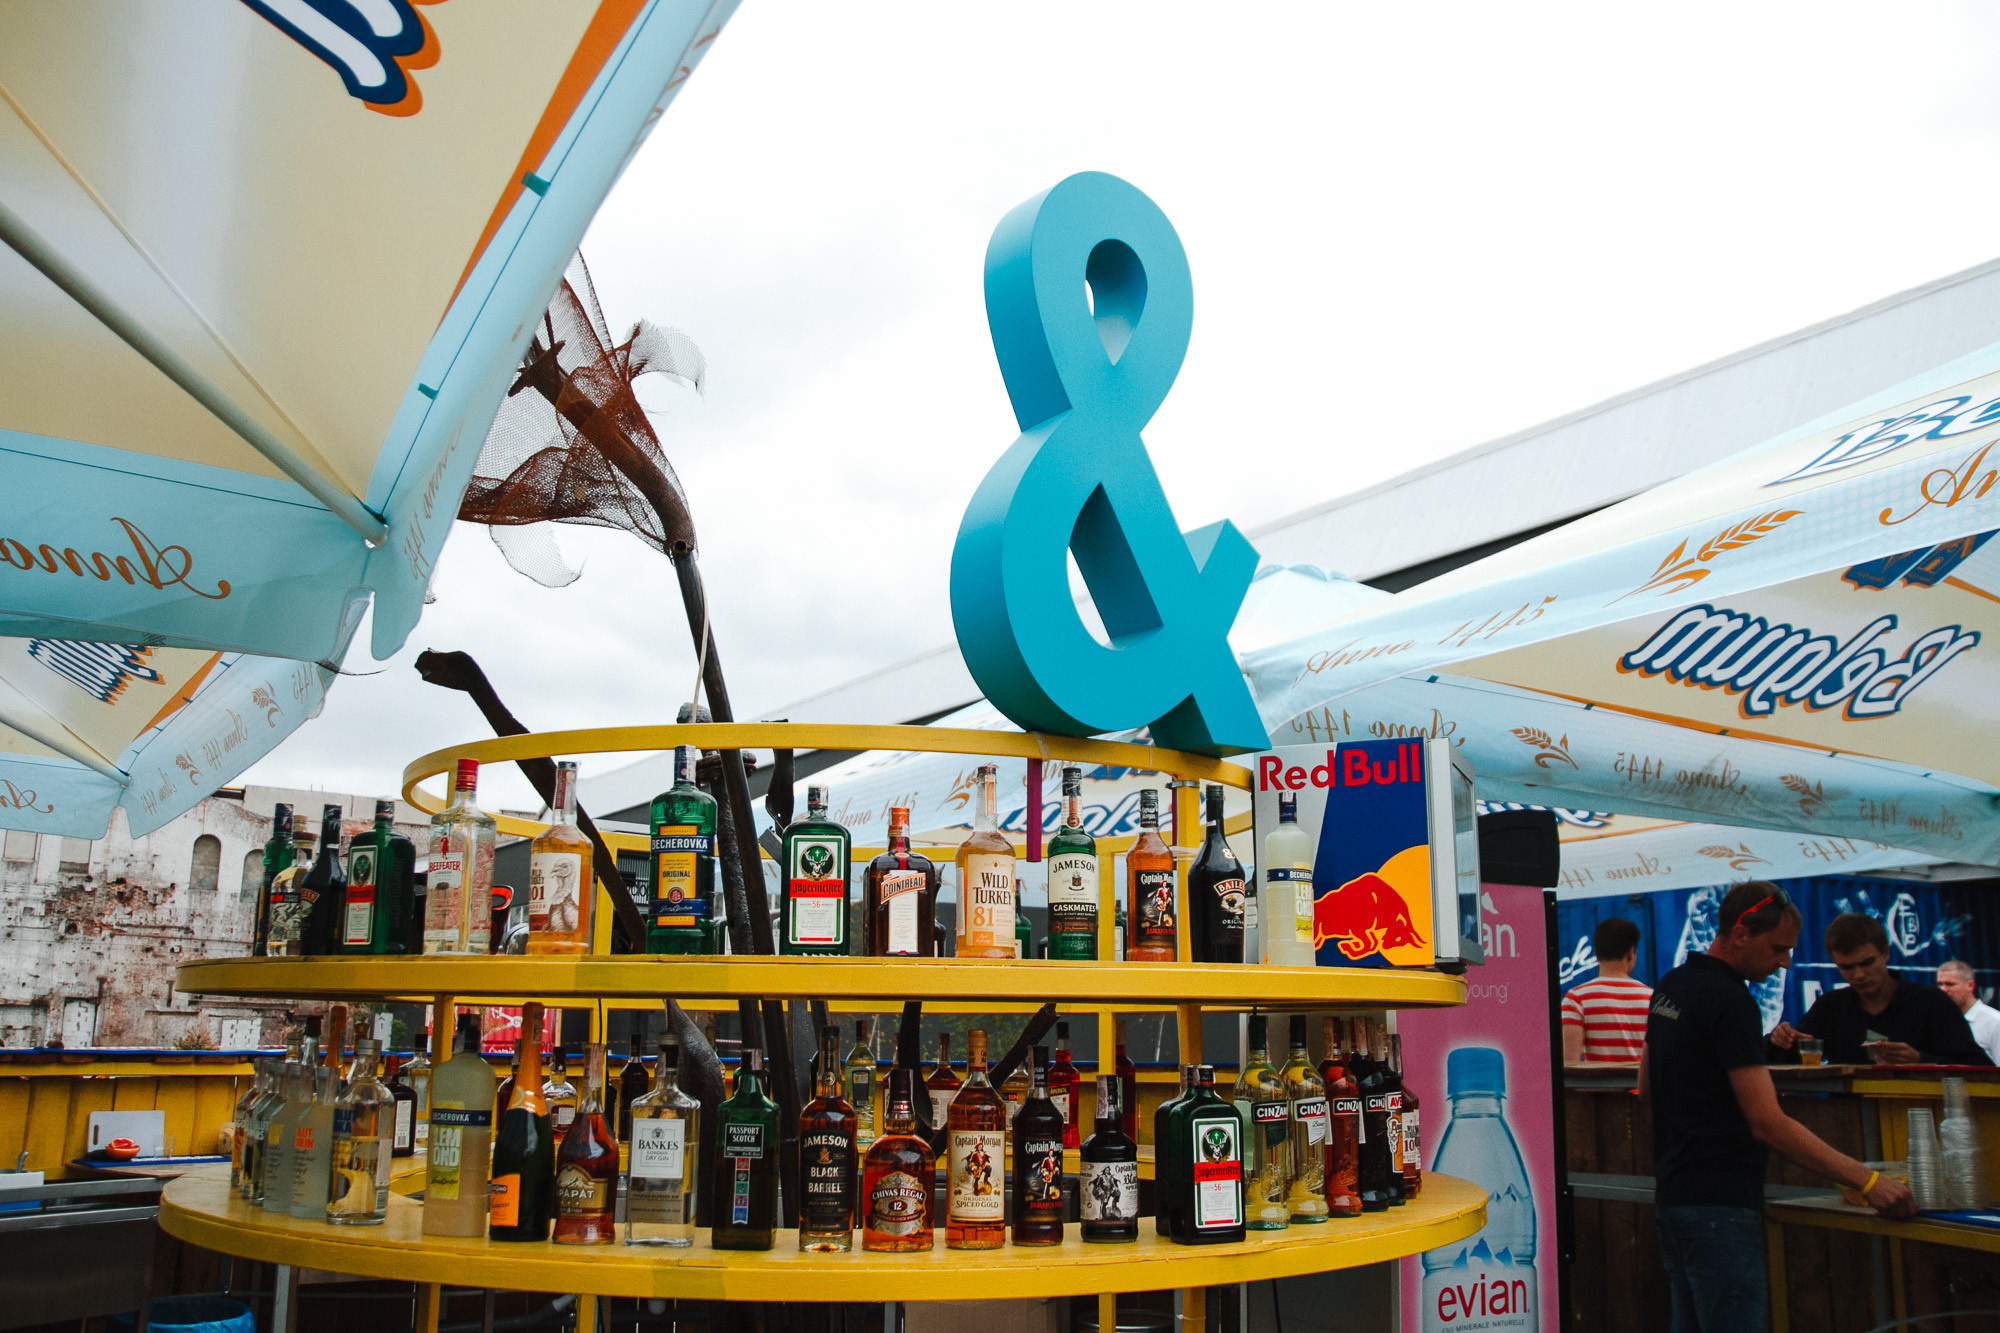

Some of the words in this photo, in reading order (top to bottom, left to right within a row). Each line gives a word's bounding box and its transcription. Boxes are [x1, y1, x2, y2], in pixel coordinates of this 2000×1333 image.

[1292, 637, 1415, 689] Anno
[1438, 595, 1558, 647] 1445
[1259, 749, 1336, 791] Red
[1343, 743, 1422, 787] Bull
[651, 838, 708, 850] BECHEROVKA
[429, 860, 461, 873] BEEFEATER
[1053, 860, 1095, 873] JAMESON
[662, 870, 692, 878] ORIGINAL
[981, 872, 1009, 889] WILD
[1140, 873, 1163, 885] Captain
[531, 885, 545, 900] 01
[792, 882, 842, 894] Jägermeister
[883, 877, 924, 898] COINTREAU
[1218, 880, 1244, 893] BAILE
[973, 887, 1012, 905] TURKEY
[811, 900, 821, 908] 56
[1053, 904, 1096, 912] CASKMATES
[973, 906, 994, 927] 81
[1256, 1105, 1287, 1118] CINZAN
[1299, 1103, 1326, 1116] CINZA
[729, 1126, 760, 1134] PASSPORT
[434, 1127, 462, 1147] LEM
[732, 1134, 756, 1143] SCOTCH
[803, 1135, 848, 1148] JAMESON
[955, 1134, 978, 1148] Captain
[978, 1134, 1002, 1148] Morgan
[638, 1139, 679, 1150] BANKES
[1025, 1141, 1049, 1154] Captain
[810, 1166, 839, 1178] BLACK
[1196, 1165, 1239, 1178] Jägermeister
[808, 1182, 842, 1193] BARREL
[1214, 1183, 1222, 1191] 56
[872, 1188, 898, 1200] CHIVAS
[899, 1188, 924, 1201] REGAL
[893, 1201, 903, 1211] 12
[956, 1200, 981, 1209] SPICED
[981, 1201, 999, 1209] GOLD
[1438, 1273, 1528, 1323] evian
[1456, 1321, 1490, 1332] MINERALE
[1492, 1318, 1526, 1328] NATURELLE
